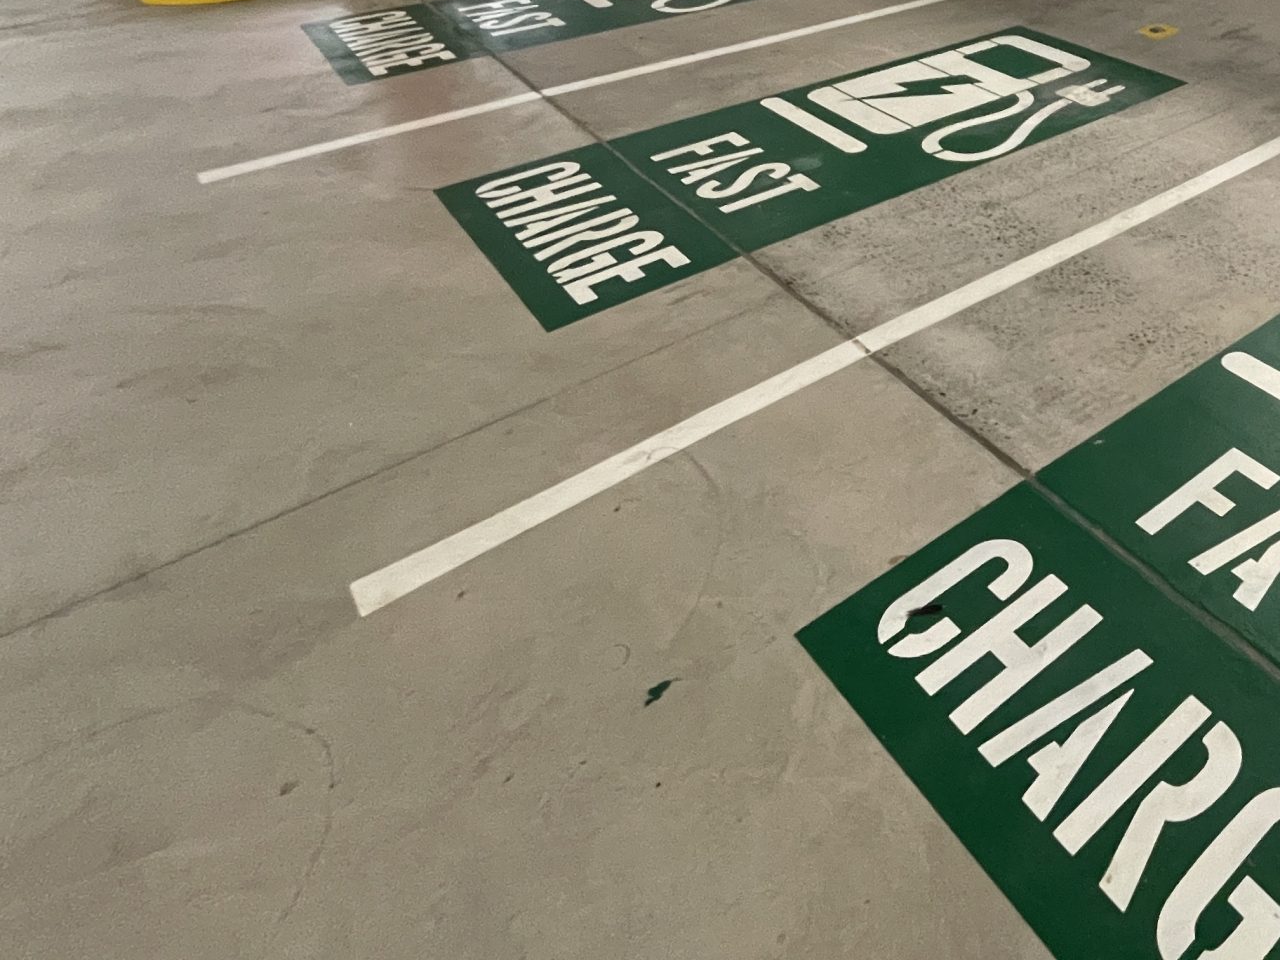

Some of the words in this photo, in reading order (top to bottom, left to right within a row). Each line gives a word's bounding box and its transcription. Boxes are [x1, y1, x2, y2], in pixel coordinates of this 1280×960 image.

[328, 10, 457, 76] CHARGE
[650, 131, 822, 214] FAST
[475, 161, 692, 305] CHARGE
